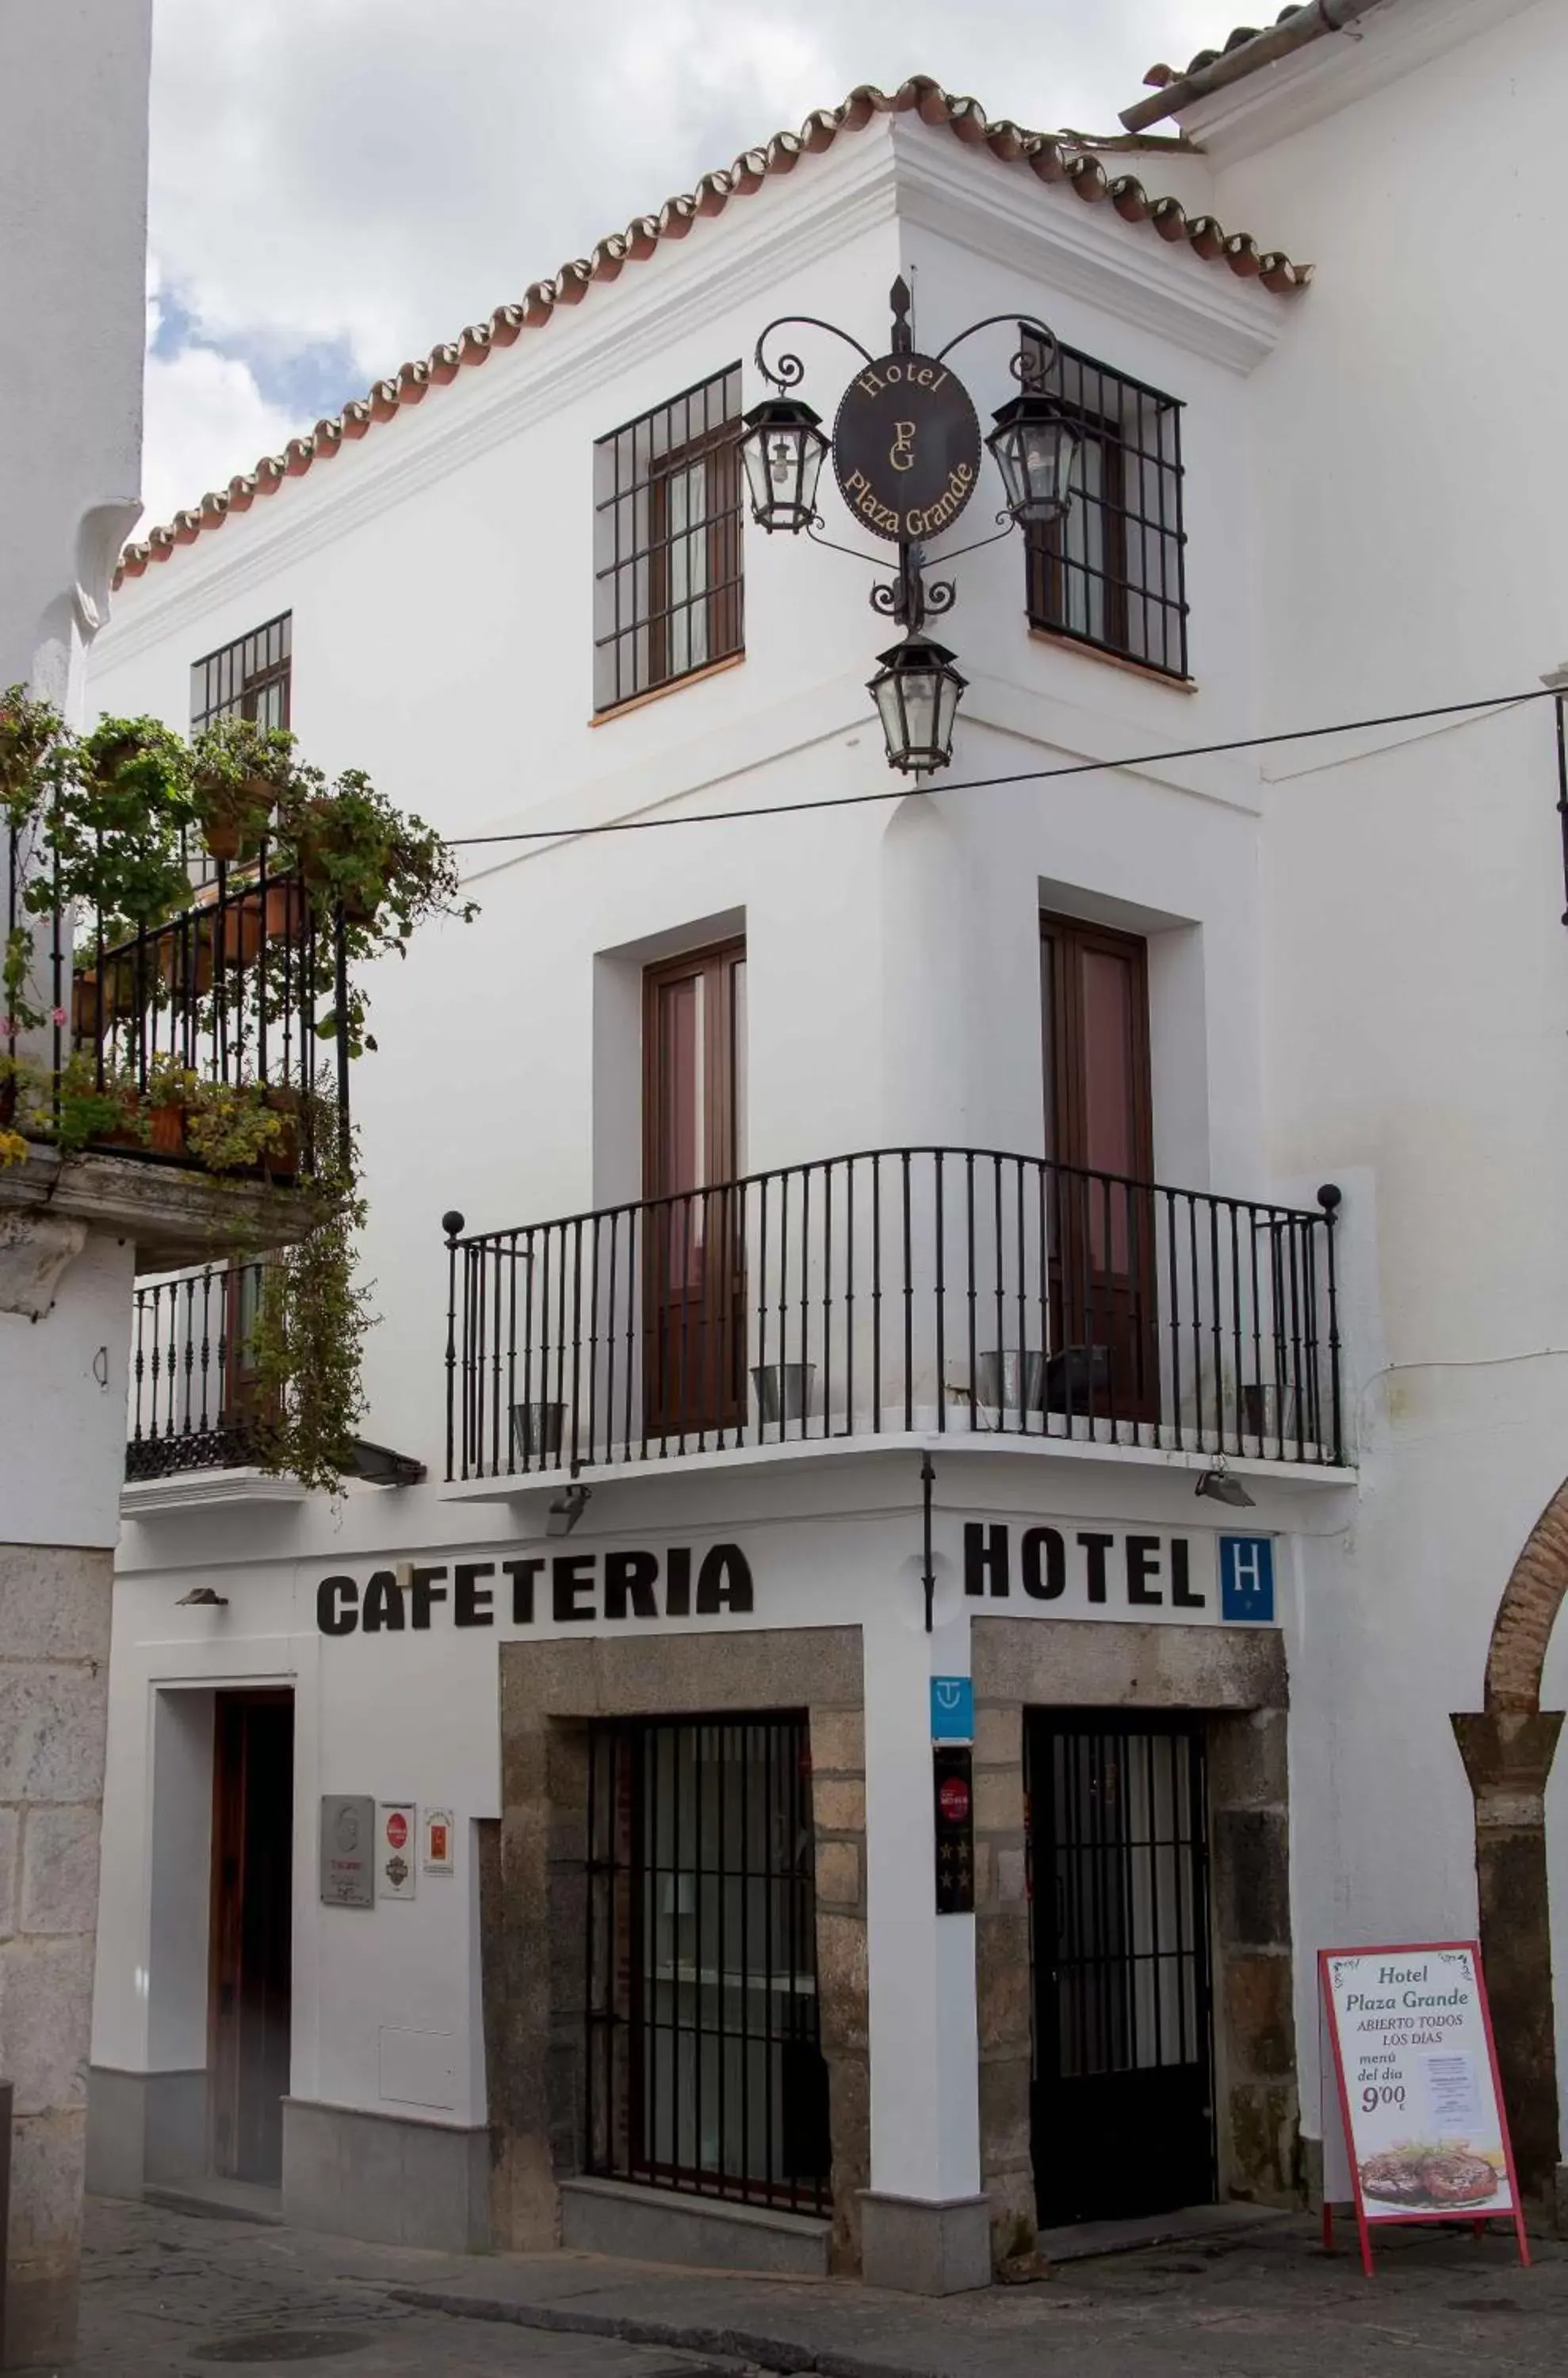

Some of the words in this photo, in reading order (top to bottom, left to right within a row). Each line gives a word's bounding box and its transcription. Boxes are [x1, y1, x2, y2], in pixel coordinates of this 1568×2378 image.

[858, 362, 949, 398] Hotel
[844, 469, 900, 533] Plaza
[905, 463, 973, 535] Grande
[964, 1523, 1205, 1608] HOTEL
[1233, 1543, 1261, 1592] H
[316, 1543, 754, 1635] CAFETERIA
[1378, 1966, 1428, 1984] Hotel
[1346, 1994, 1396, 2012] Plaza
[1402, 1987, 1468, 2008] Grande
[1357, 2017, 1414, 2032] ABIERTO
[1418, 2013, 1464, 2028] TODOS
[1383, 2034, 1409, 2046] LOS
[1357, 2067, 1378, 2082] del
